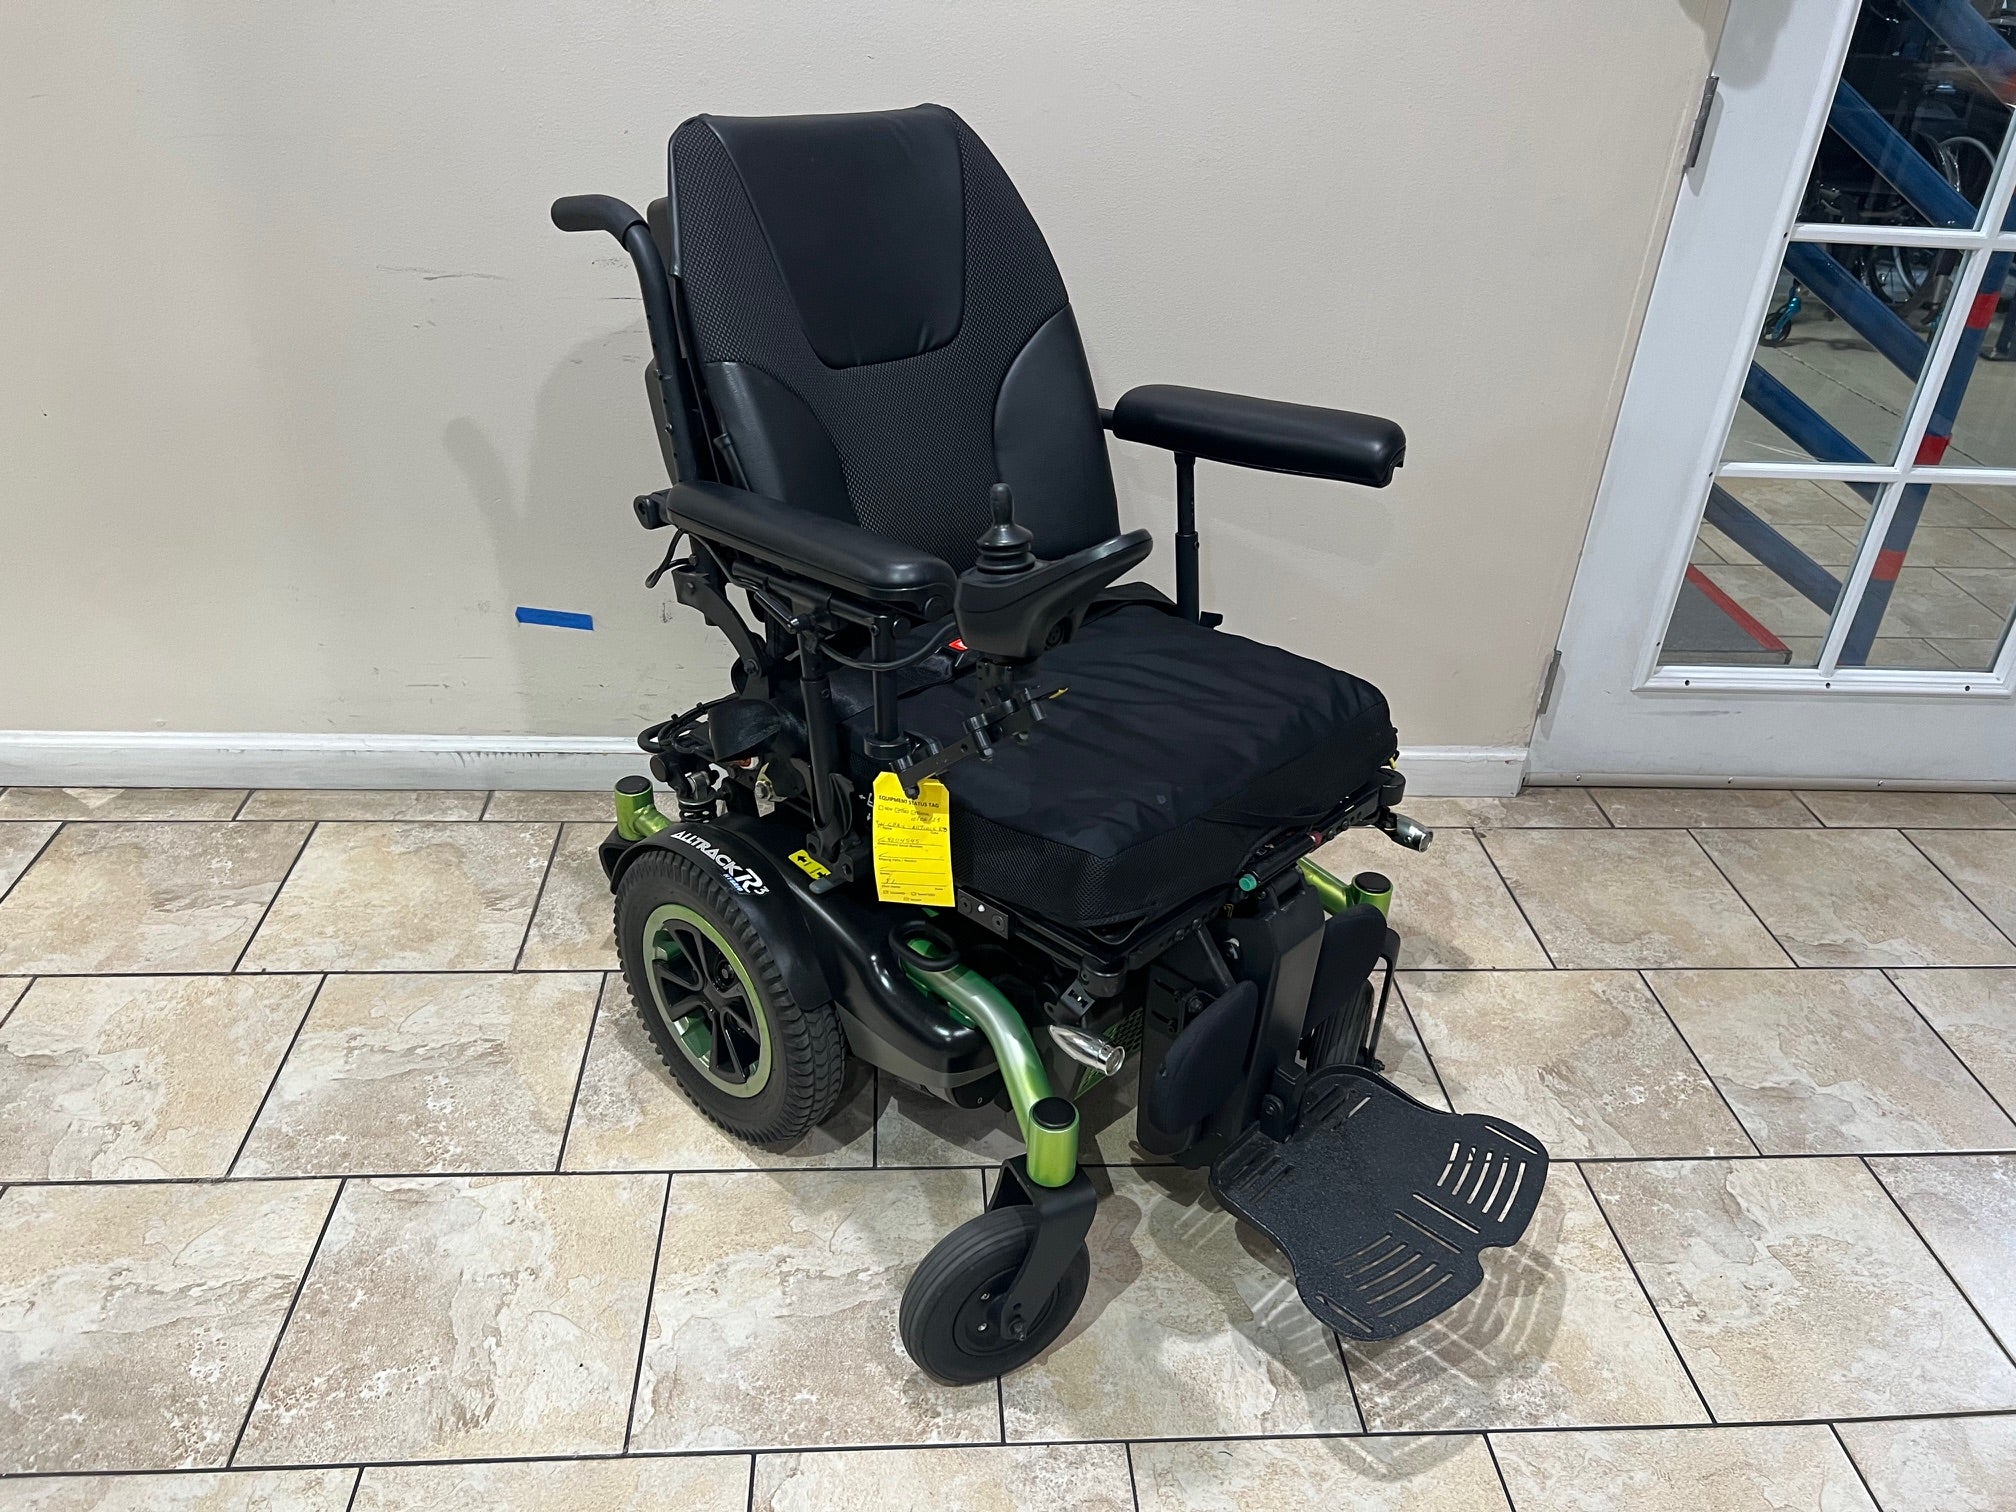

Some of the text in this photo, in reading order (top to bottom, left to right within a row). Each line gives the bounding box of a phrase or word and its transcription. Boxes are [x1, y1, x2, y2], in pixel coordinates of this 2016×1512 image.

[879, 795, 907, 804] EQUIPMENT
[908, 800, 928, 808] STATUS
[670, 830, 744, 876] ALLTRACK
